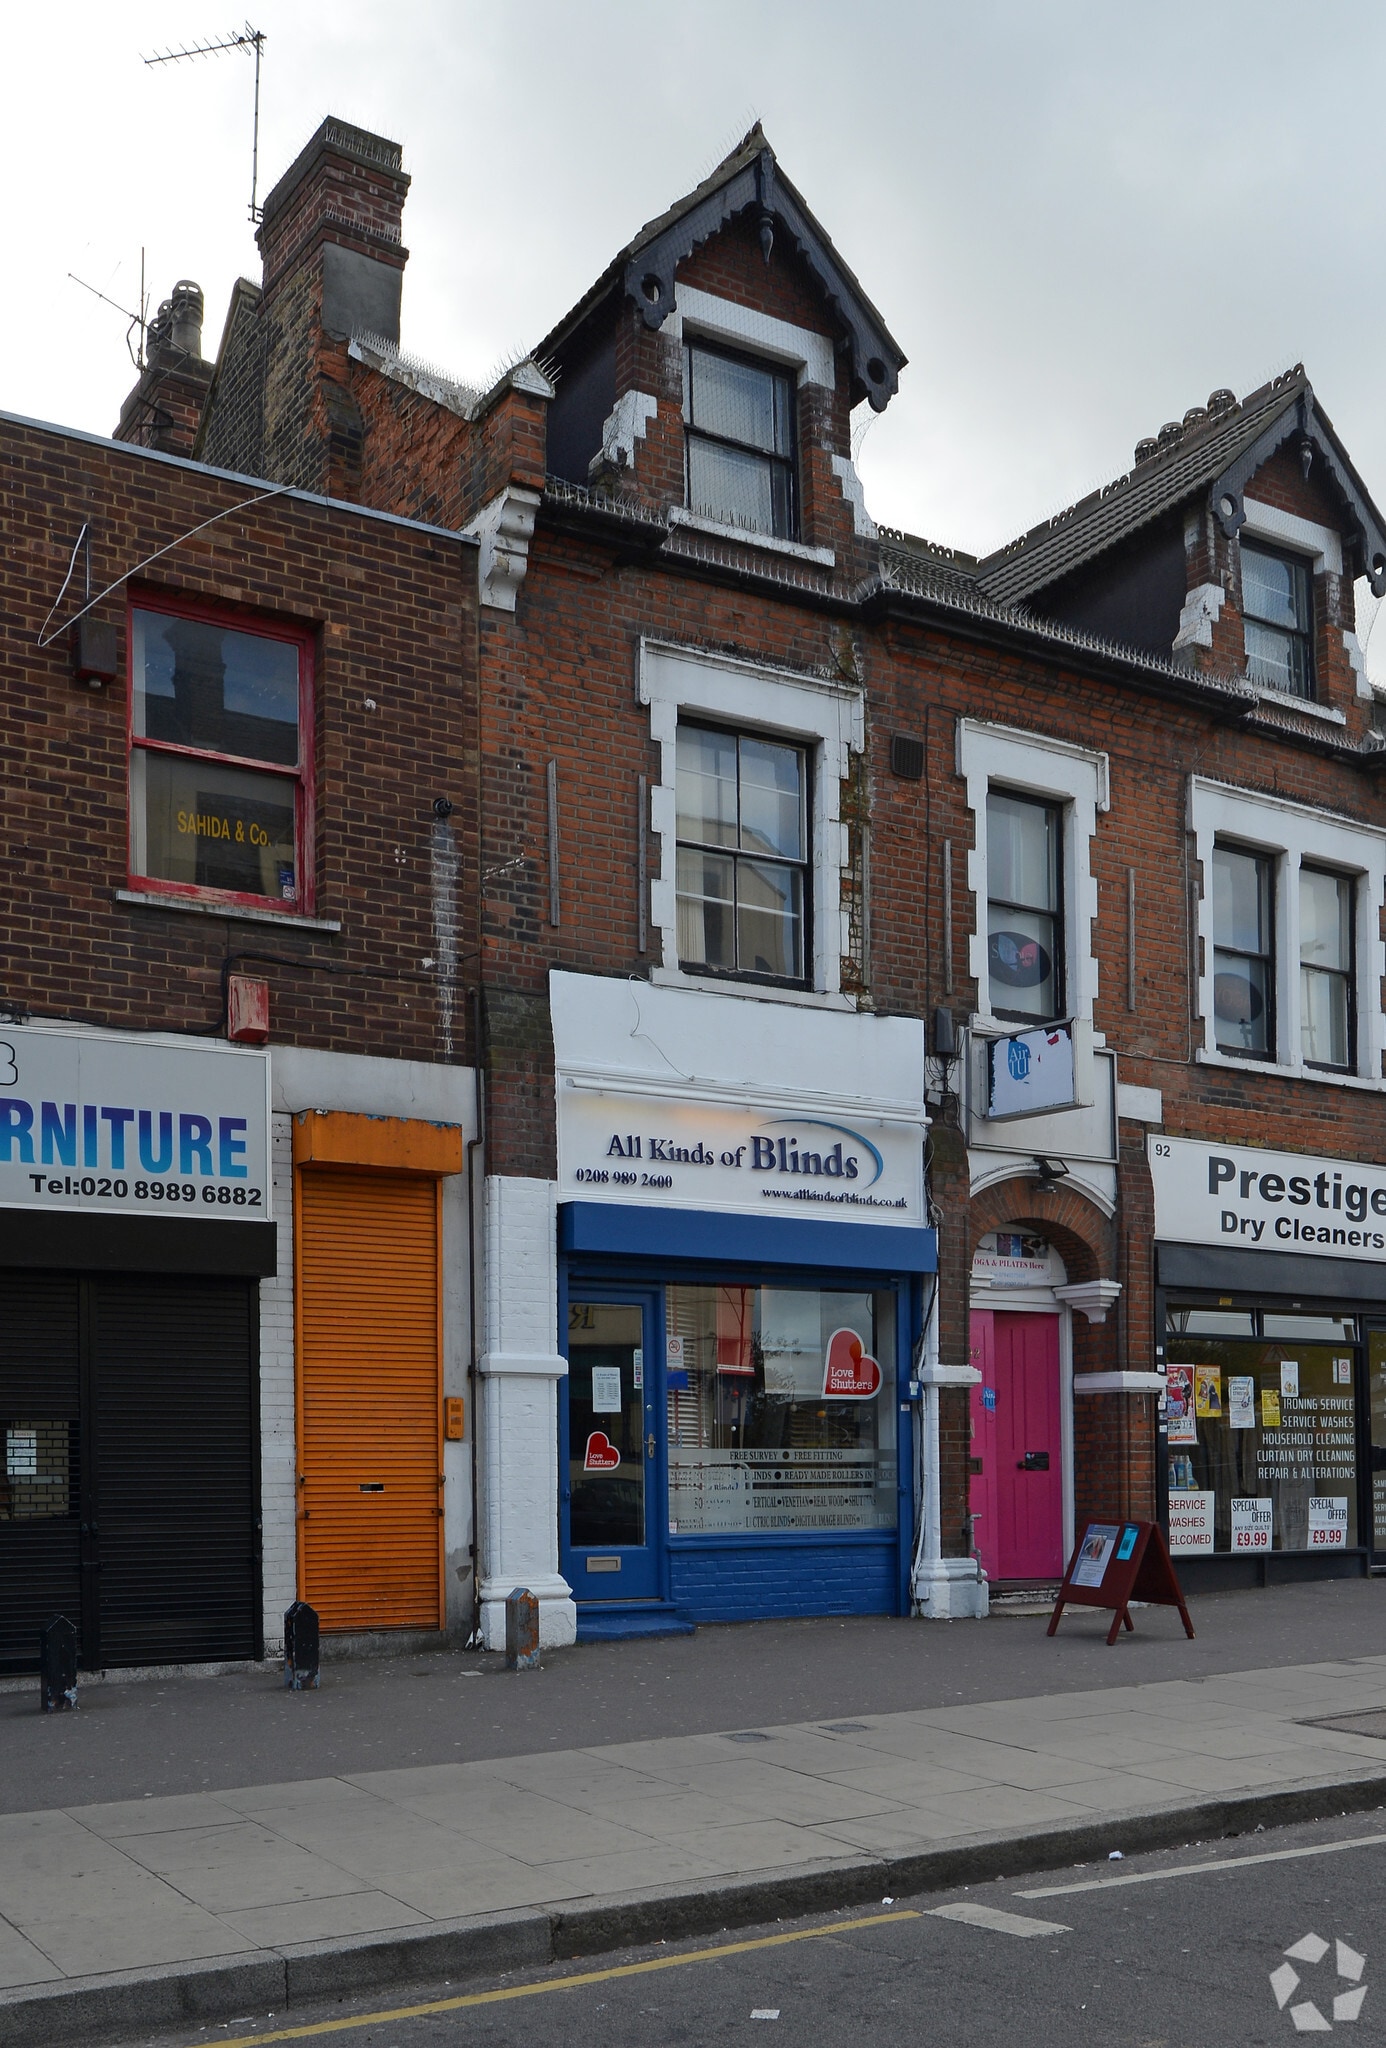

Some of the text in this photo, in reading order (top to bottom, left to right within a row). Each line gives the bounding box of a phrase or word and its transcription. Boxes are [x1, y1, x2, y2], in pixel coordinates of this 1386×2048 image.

[177, 809, 272, 847] SAHIDA & Co.
[0, 1098, 248, 1178] RNITURE
[606, 1133, 859, 1180] All Kinds of Blinds
[1155, 1143, 1171, 1158] 92
[575, 1167, 673, 1189] 0208 989 2600
[29, 1173, 262, 1207] Tel:020 8989 6882
[1207, 1156, 1386, 1223] Prestige
[761, 1187, 908, 1209] www.allkindsofblinds.co.uk
[1220, 1209, 1385, 1250] Dry Cleaners
[999, 1259, 1028, 1269] PILATES
[831, 1366, 854, 1378] Love
[830, 1378, 873, 1390] Shutters
[1283, 1397, 1354, 1411] IRONING SERVICE
[1281, 1415, 1354, 1428] SERVICE WASHES
[1262, 1432, 1355, 1445] HOUSEHOLD CLEANING
[729, 1450, 843, 1461] FREE SURVEY FREE FITTING
[1256, 1449, 1355, 1462] CURTAIN DRY CLEANING
[784, 1470, 809, 1481] READY
[809, 1470, 832, 1480] MADE
[833, 1470, 864, 1480] ROLLERS
[1258, 1466, 1356, 1479] REPAIR & ALTERATIONS
[1168, 1499, 1206, 1511] SERVICE
[1232, 1500, 1259, 1512] SPECIAL
[1309, 1498, 1335, 1510] SPECIAL
[1251, 1511, 1272, 1523] OFFER
[1327, 1509, 1347, 1520] OFFER
[1169, 1517, 1206, 1528] WASHES
[1237, 1532, 1268, 1547] £9.99
[1312, 1530, 1342, 1544] £9.99
